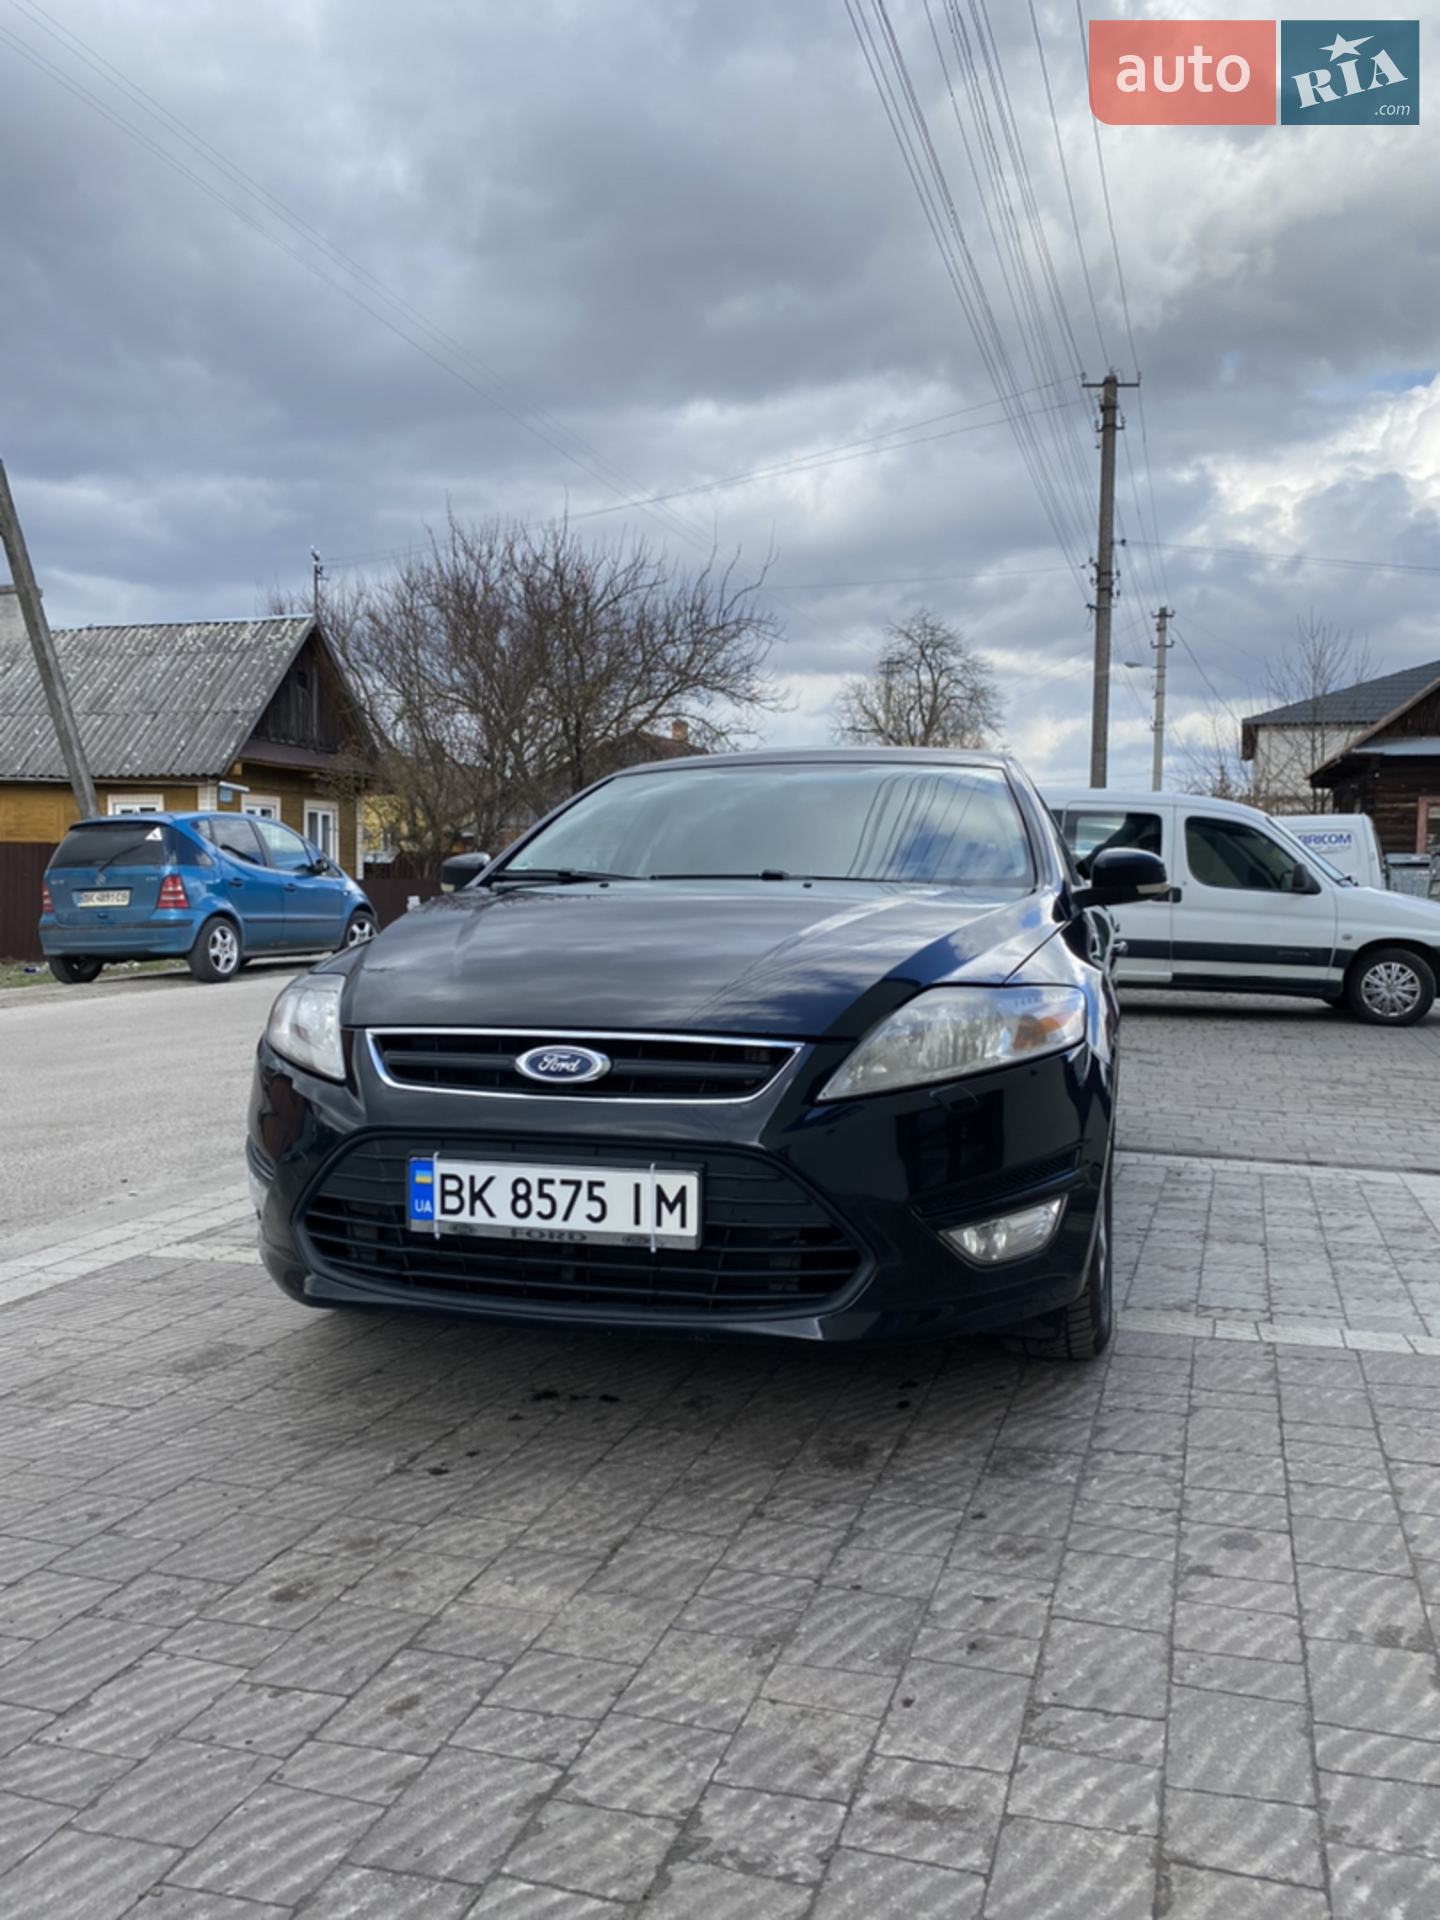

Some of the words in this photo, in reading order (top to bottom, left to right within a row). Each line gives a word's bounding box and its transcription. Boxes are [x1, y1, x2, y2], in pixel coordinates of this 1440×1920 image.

[538, 1053, 581, 1072] Ford
[415, 1199, 433, 1213] UA
[439, 1173, 497, 1218] BK
[510, 1177, 608, 1223] 8575
[633, 1182, 688, 1229] IM
[510, 1228, 588, 1242] FORD
